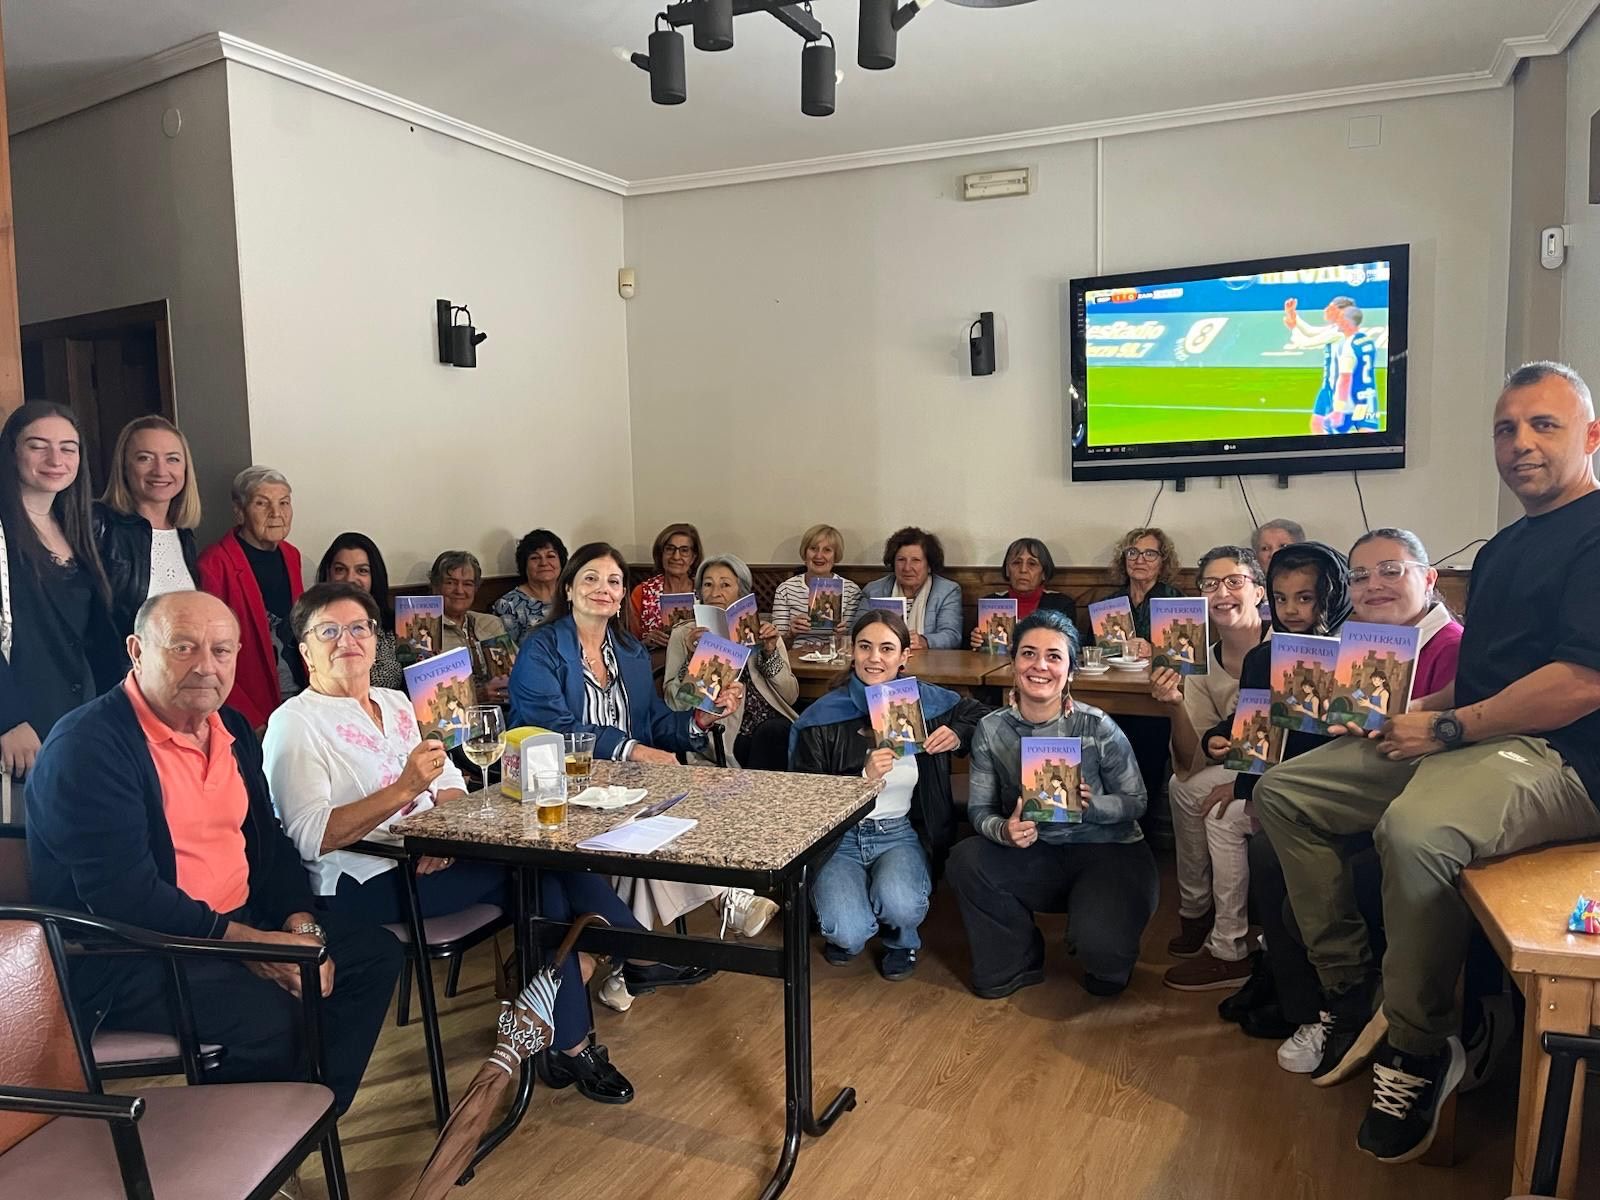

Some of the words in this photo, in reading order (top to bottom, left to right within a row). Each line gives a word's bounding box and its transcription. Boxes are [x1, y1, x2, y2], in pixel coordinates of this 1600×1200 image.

[1348, 633, 1412, 647] PONFERRADA
[1279, 641, 1335, 657] PONFERRADA
[413, 659, 467, 685] PONFERRADA
[871, 687, 914, 700] PONERRADA
